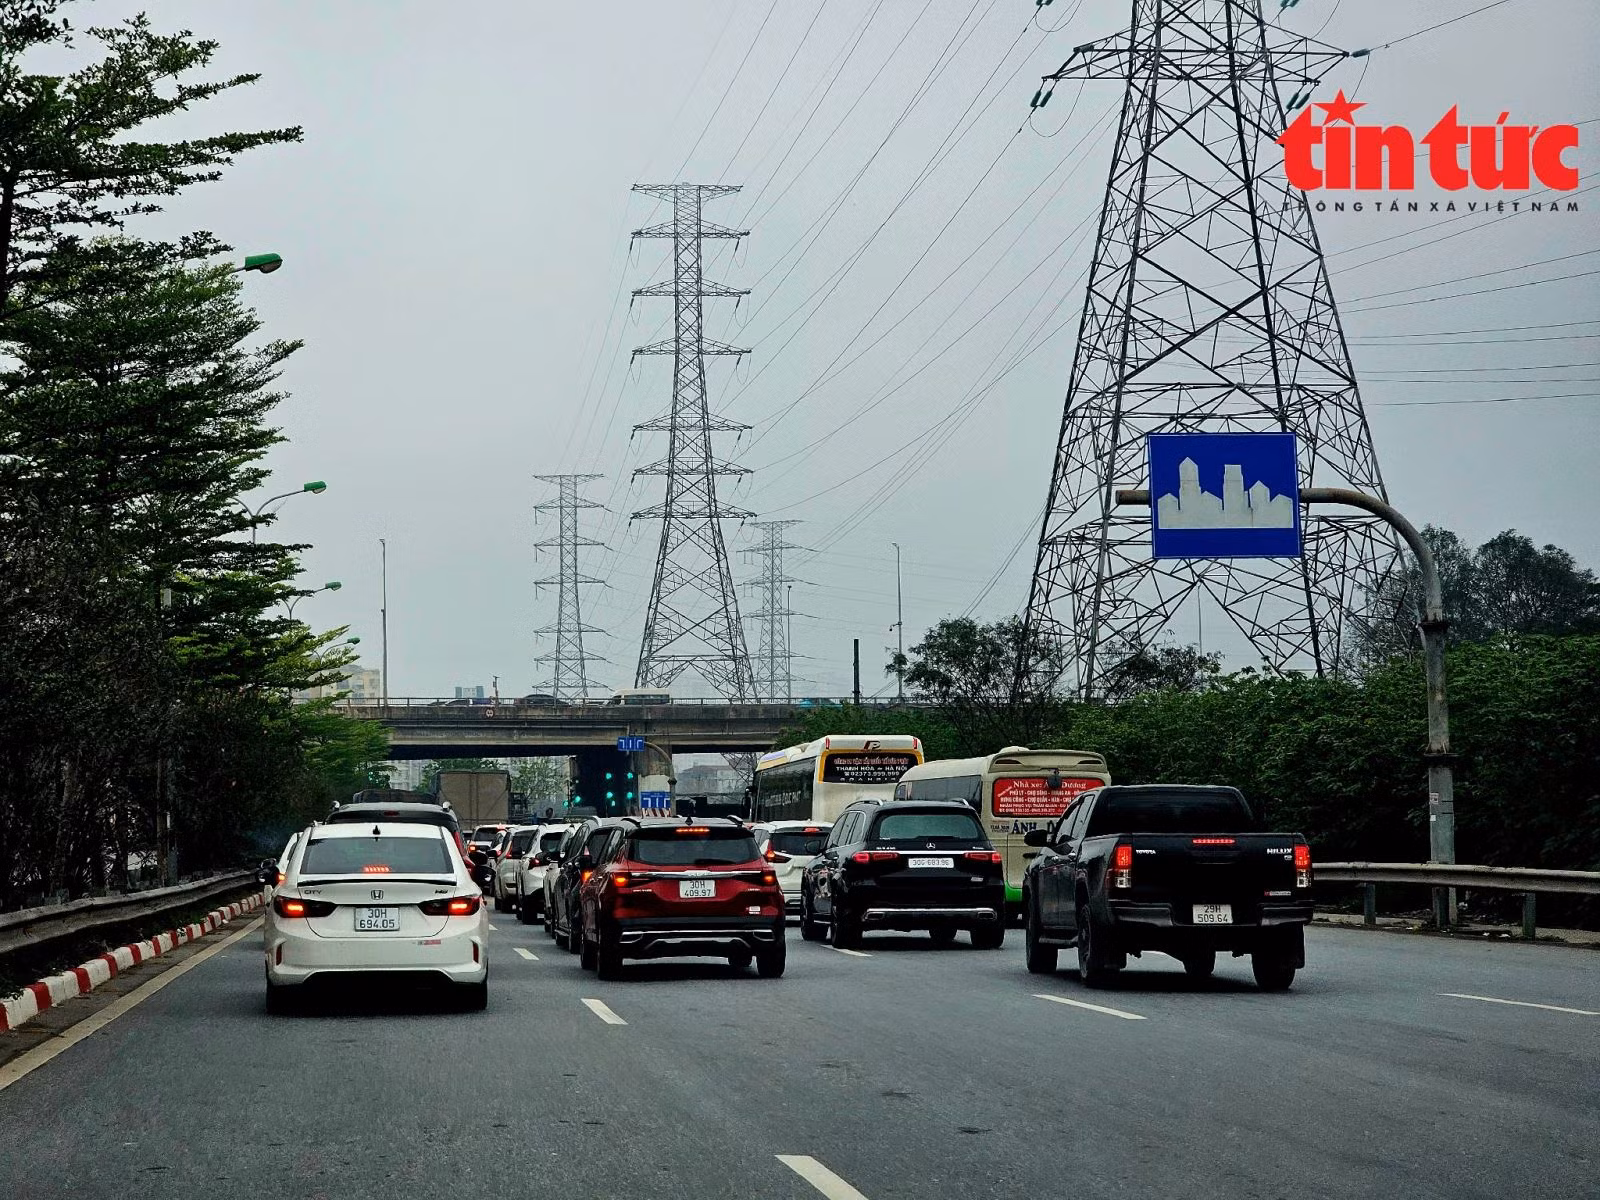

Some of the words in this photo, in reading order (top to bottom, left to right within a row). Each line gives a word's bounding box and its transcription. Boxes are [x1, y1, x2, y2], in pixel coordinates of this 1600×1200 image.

[690, 880, 706, 888] 30H
[684, 889, 711, 897] 409.97
[368, 908, 387, 918] 30H
[1204, 905, 1221, 913] 29H
[1198, 914, 1228, 923] 509.64
[360, 919, 395, 929] 694.05
